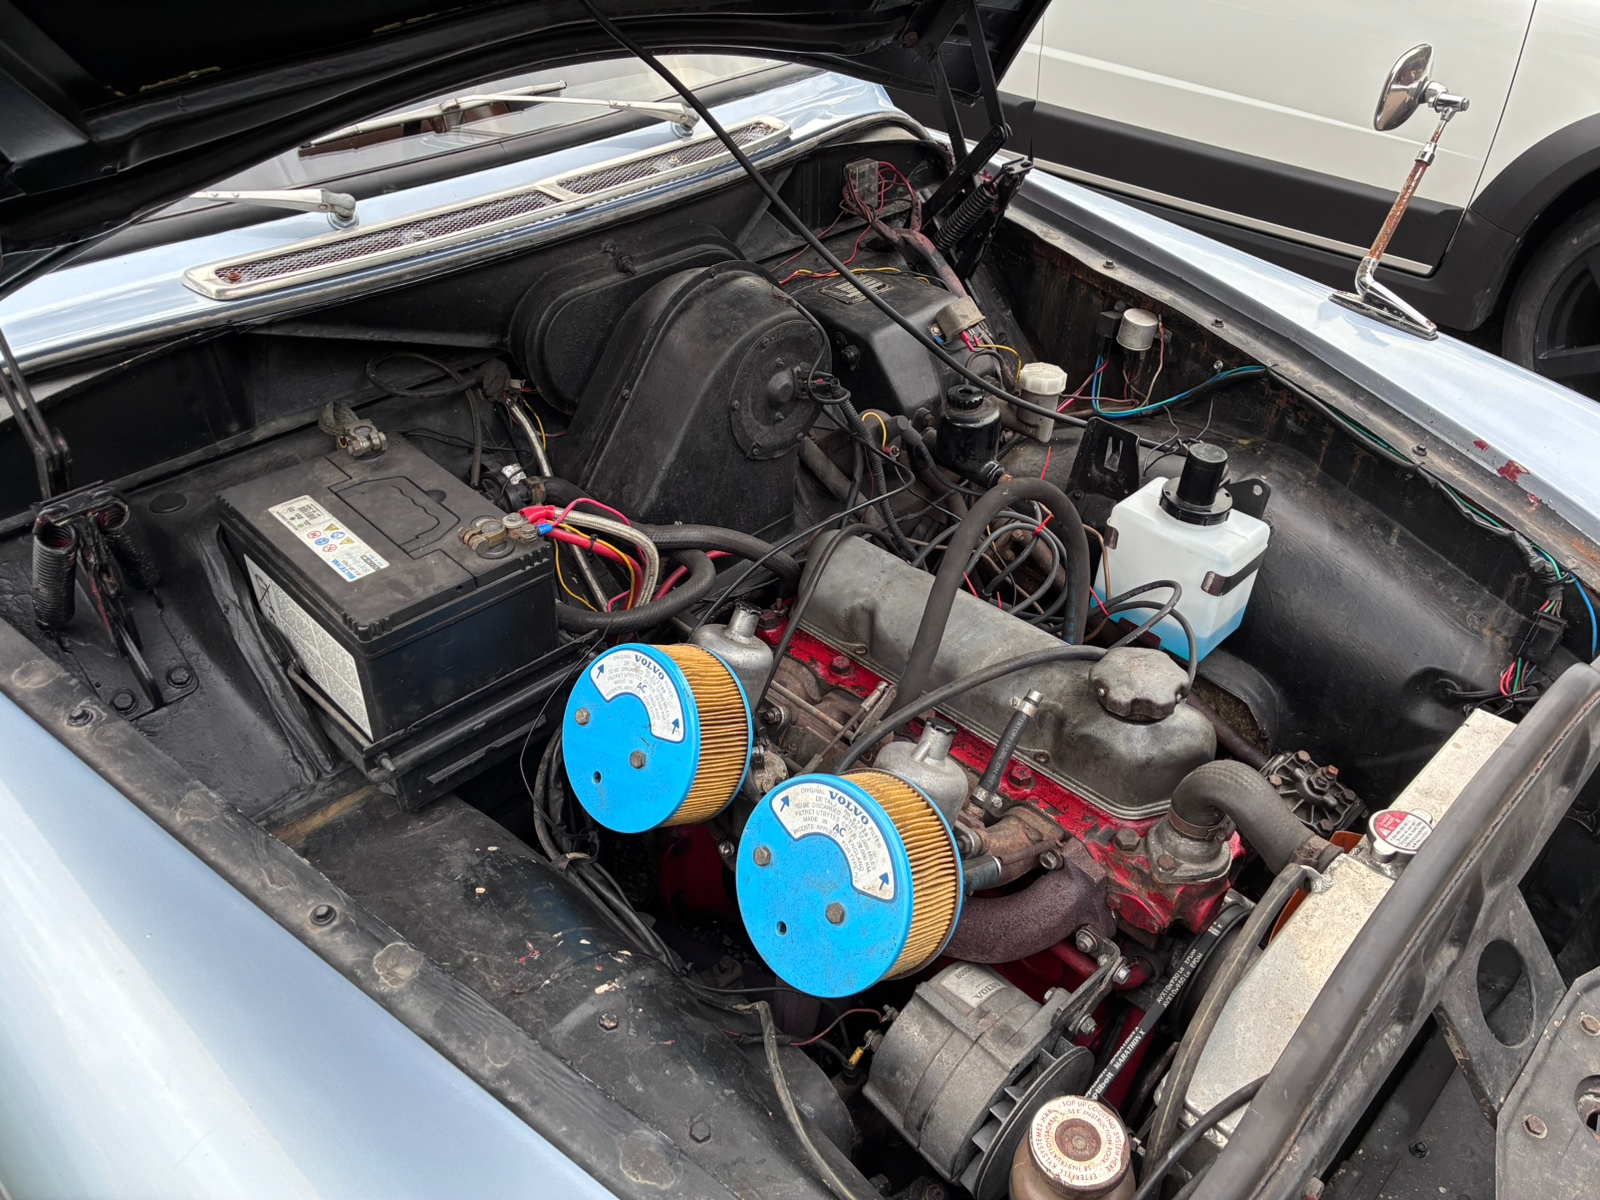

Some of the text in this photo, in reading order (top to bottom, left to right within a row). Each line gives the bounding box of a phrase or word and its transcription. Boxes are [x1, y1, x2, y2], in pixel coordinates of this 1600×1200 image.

[634, 654, 665, 680] VOLVO
[637, 682, 647, 693] AC
[812, 802, 841, 815] DISCARDED
[816, 810, 840, 822] UTBYTES
[828, 790, 869, 825] VOLVO
[869, 827, 881, 849] FILTER
[832, 824, 846, 837] AC
[794, 824, 858, 871] PATENTS APPLIED FOR TYPE
[848, 839, 864, 872] ENGLAND
[1191, 953, 1203, 969] EPDM
[973, 981, 1001, 999] VOLVO
[1113, 1034, 1142, 1070] MARATHON
[1087, 1103, 1116, 1130] COOLING
[1035, 1124, 1057, 1169] KYLSYSTEMET
[1083, 1110, 1113, 1145] INSTRUCTION
[1101, 1146, 1113, 1165] BOOK
[1113, 1130, 1122, 1156] SYSTEM
[1106, 1156, 1119, 1173] HERE
